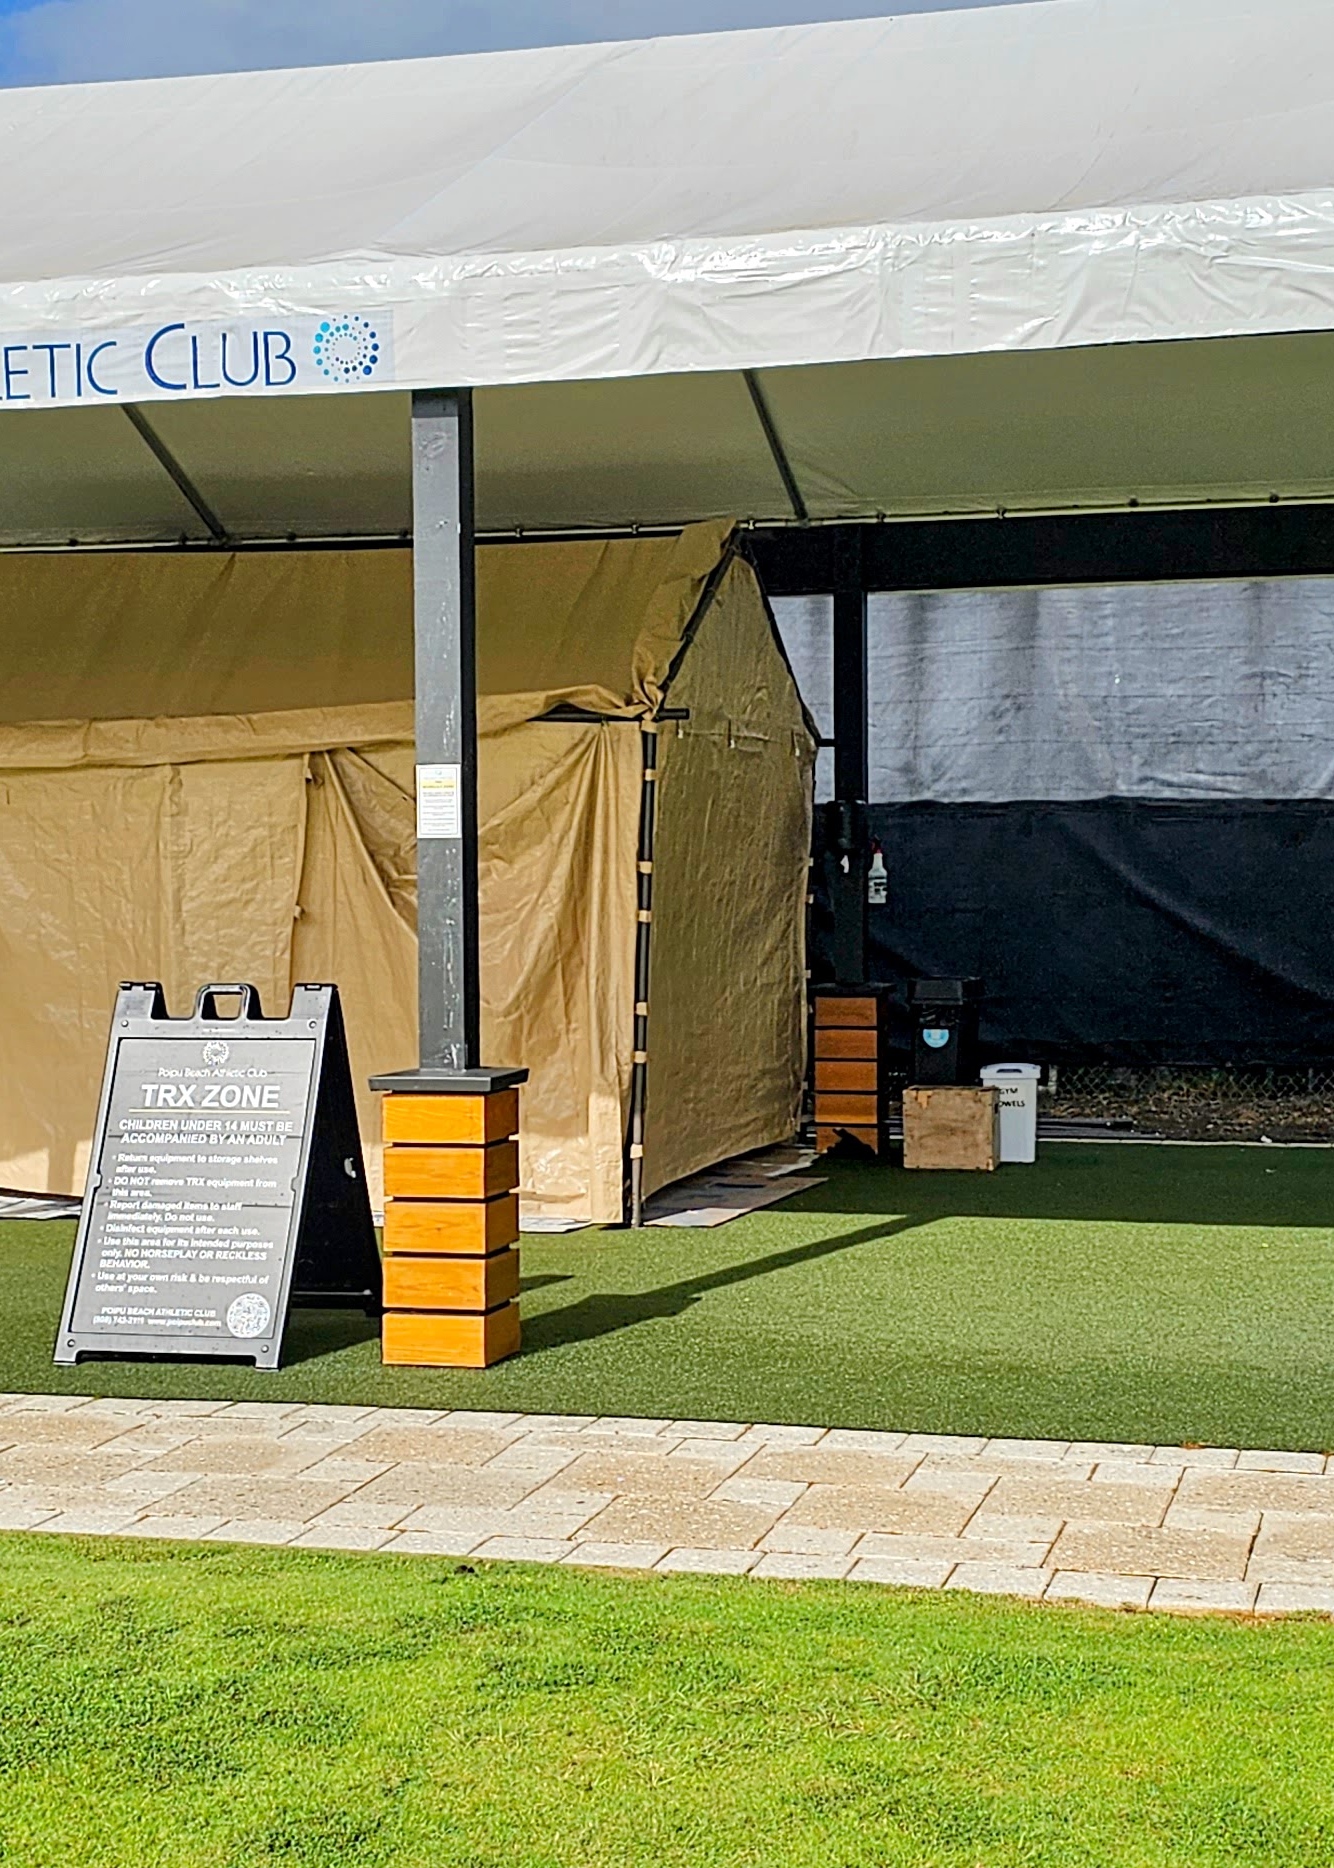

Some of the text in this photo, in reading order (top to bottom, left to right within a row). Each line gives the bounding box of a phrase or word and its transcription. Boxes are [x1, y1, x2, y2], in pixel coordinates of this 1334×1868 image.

[143, 322, 298, 391] CLUB
[246, 1068, 268, 1079] Club
[141, 1084, 281, 1108] TRX ZONE
[998, 1100, 1026, 1108] OWELS
[119, 1119, 293, 1132] CHILDREN UNDER 14 MUST BE
[120, 1133, 287, 1146] ACCOMPANIED BY AN ADULT
[117, 1153, 278, 1166] Return equipment to storage shelves
[116, 1165, 157, 1174] after use.
[113, 1177, 277, 1189] DO NOT remove TRX equipment from
[112, 1188, 129, 1197] this
[109, 1200, 243, 1211] Report damaged items to staff
[164, 1213, 177, 1222] Do
[178, 1213, 195, 1222] not
[196, 1214, 215, 1222] use.
[105, 1223, 261, 1236] Disinfect equipment after each use.
[103, 1237, 274, 1250] Use this area for its intended purposes
[124, 1249, 139, 1258] NO
[140, 1249, 198, 1259] HORSEPLAY
[199, 1250, 216, 1260] OR
[216, 1251, 267, 1261] RECKLESS
[97, 1271, 115, 1281] Use
[116, 1272, 126, 1281] at
[127, 1273, 148, 1283] your
[149, 1274, 169, 1282] own
[170, 1273, 189, 1282] risk
[198, 1274, 210, 1283] be
[211, 1274, 258, 1285] respectful
